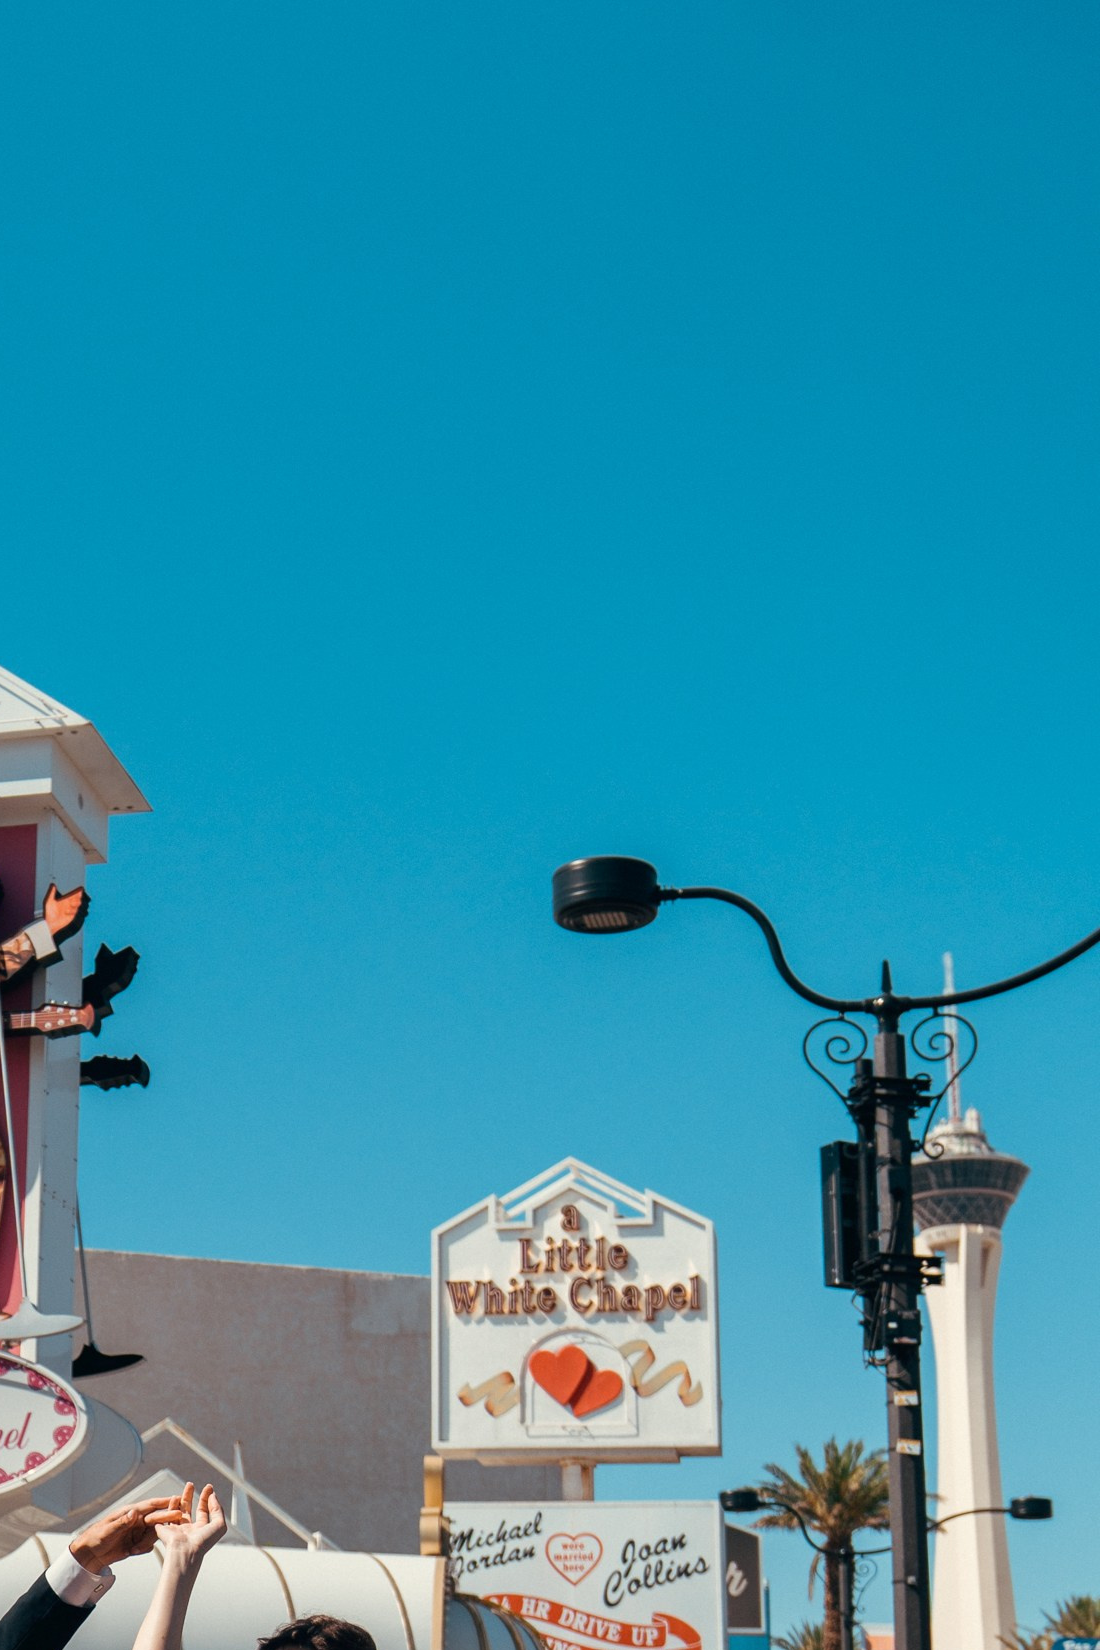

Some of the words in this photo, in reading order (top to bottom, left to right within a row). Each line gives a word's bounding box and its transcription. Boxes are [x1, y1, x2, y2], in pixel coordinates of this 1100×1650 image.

[560, 1205, 581, 1232] a
[518, 1237, 629, 1273] Little
[446, 1278, 557, 1315] White
[568, 1275, 702, 1322] Chapel
[451, 1512, 542, 1553] Michael
[561, 1542, 585, 1550] were
[452, 1545, 536, 1578] Jordan
[554, 1553, 594, 1561] married
[563, 1563, 585, 1572] here
[621, 1533, 688, 1578] Joan
[603, 1557, 710, 1607] Collins
[521, 1597, 552, 1620] HR
[558, 1606, 622, 1642] DRIVE
[631, 1626, 659, 1647] UP
